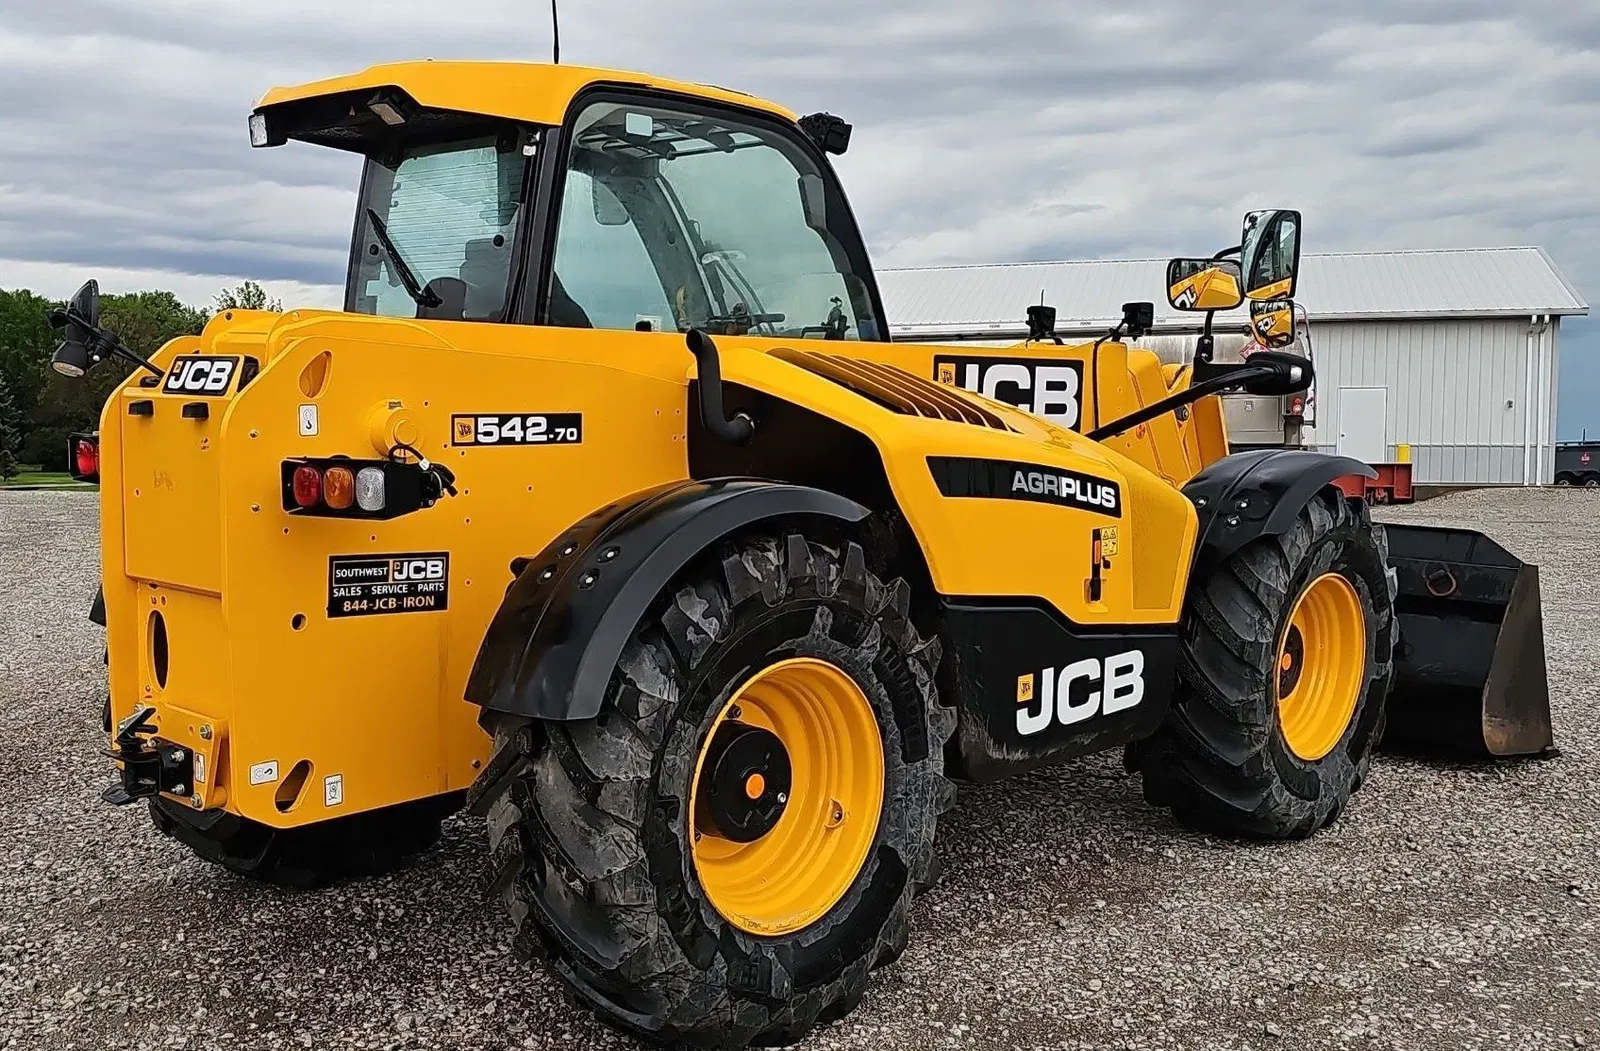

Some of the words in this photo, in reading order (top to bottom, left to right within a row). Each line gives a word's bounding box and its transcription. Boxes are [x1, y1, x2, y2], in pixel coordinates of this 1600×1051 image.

[168, 361, 233, 390] JCB
[1012, 471, 1116, 508] AGRIPLUS
[336, 567, 388, 578] SOUTHWEST
[394, 560, 443, 580] JCB
[333, 587, 361, 597] SALES
[371, 584, 408, 595] SERVICE
[418, 582, 444, 592] PARTS
[343, 595, 435, 612] 844-JCB-IRON
[1017, 650, 1144, 735] JCB
